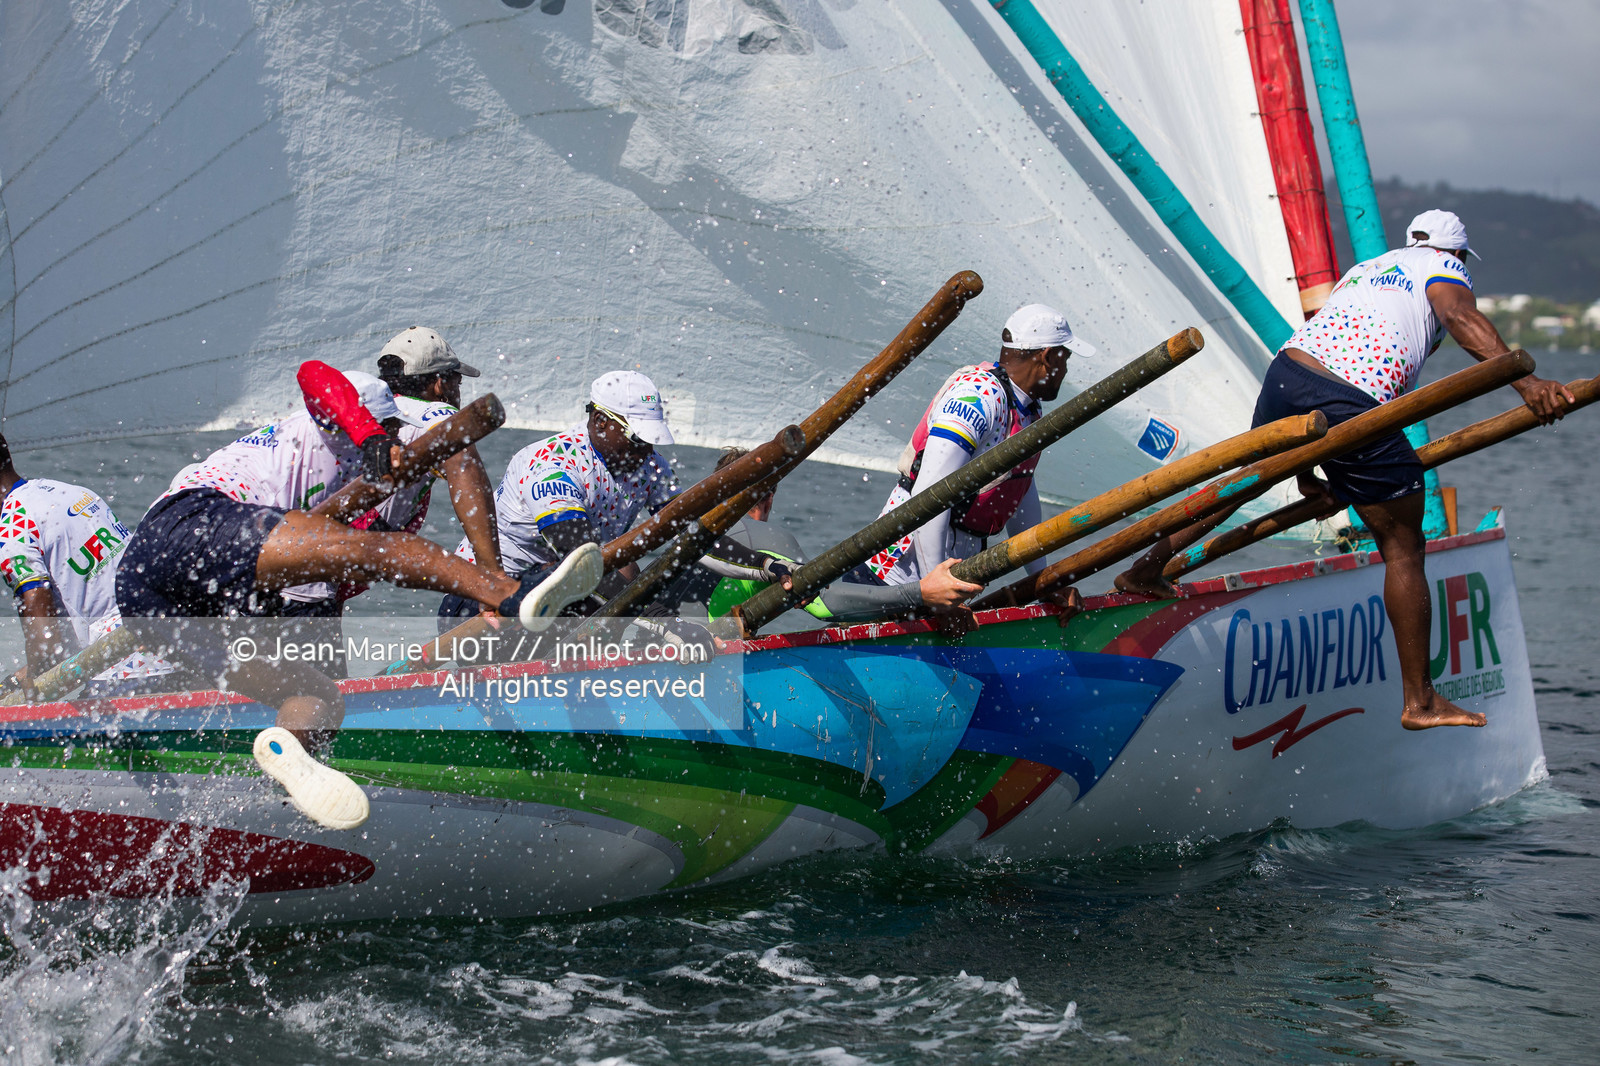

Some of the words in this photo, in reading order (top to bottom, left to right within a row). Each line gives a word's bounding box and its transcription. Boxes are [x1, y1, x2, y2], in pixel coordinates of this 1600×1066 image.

[0, 554, 35, 588] FR
[66, 527, 122, 576] UFR
[1223, 594, 1387, 715] CHANFLOR
